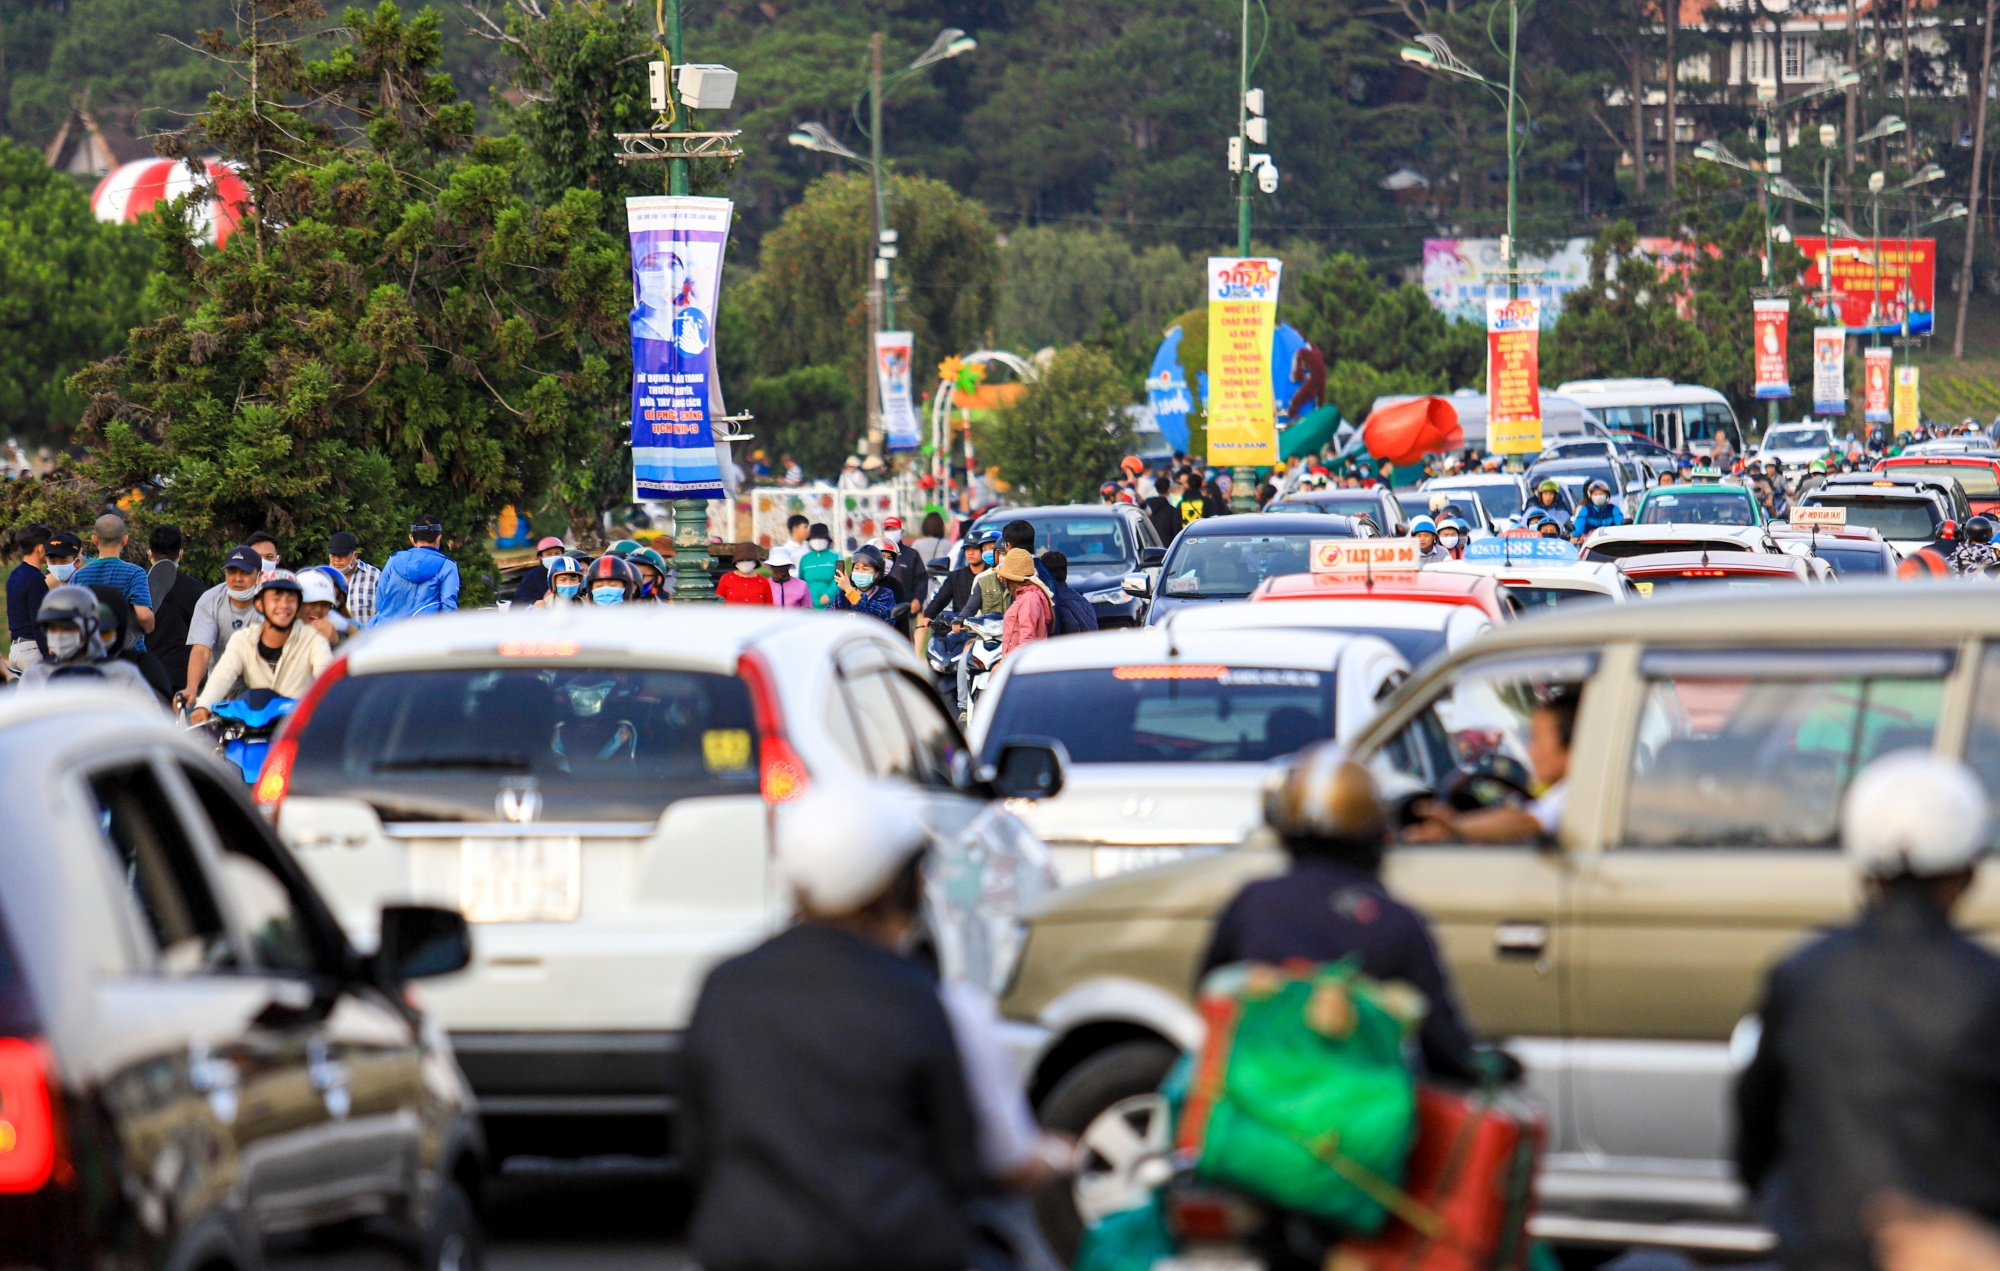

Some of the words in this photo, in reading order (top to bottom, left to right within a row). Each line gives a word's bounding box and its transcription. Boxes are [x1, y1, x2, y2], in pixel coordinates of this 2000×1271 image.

[656, 398, 671, 407] TAY
[1818, 511, 1829, 519] STAR
[1831, 511, 1841, 519] TAXI
[1503, 541, 1533, 555] 888
[1536, 541, 1566, 556] 555
[1346, 549, 1370, 563] TAXI
[1374, 548, 1394, 562] SAO
